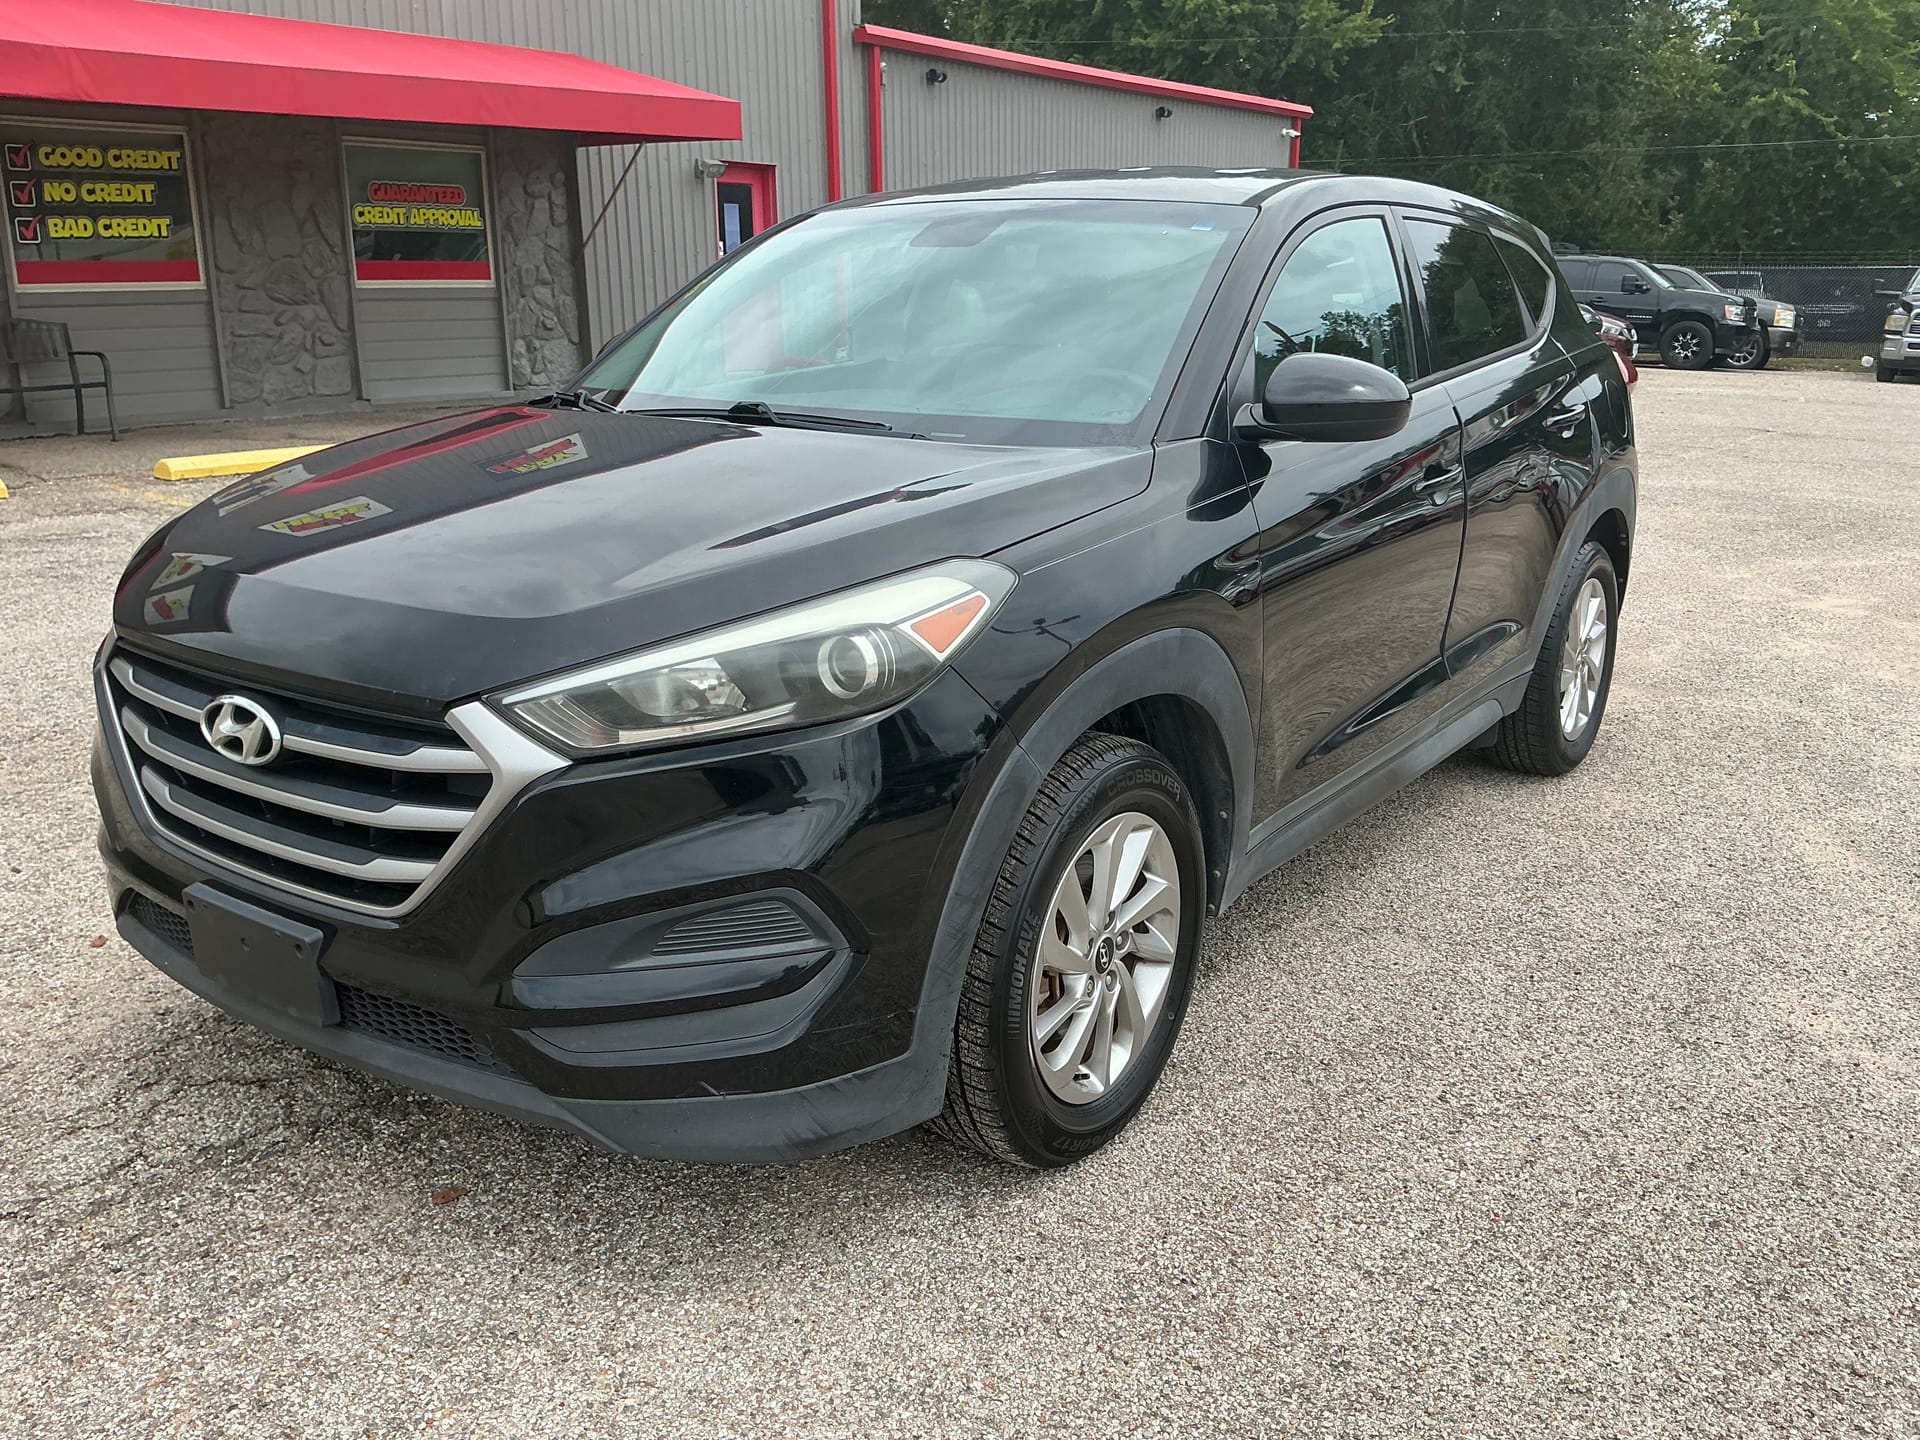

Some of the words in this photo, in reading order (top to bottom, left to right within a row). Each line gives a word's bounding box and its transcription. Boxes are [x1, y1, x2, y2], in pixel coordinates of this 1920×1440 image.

[38, 145, 104, 169] GOOD
[107, 149, 181, 171] CREDIT
[43, 181, 77, 203] NO
[81, 182, 155, 204] CREDIT
[369, 181, 466, 205] GUARANTEED
[47, 217, 94, 238] BAD
[97, 218, 171, 239] CREDIT
[354, 205, 407, 226] CREDIT
[410, 207, 483, 228] APPROVAL
[1106, 768, 1181, 796] CROSSOVER
[1008, 907, 1039, 1007] MOHAVE
